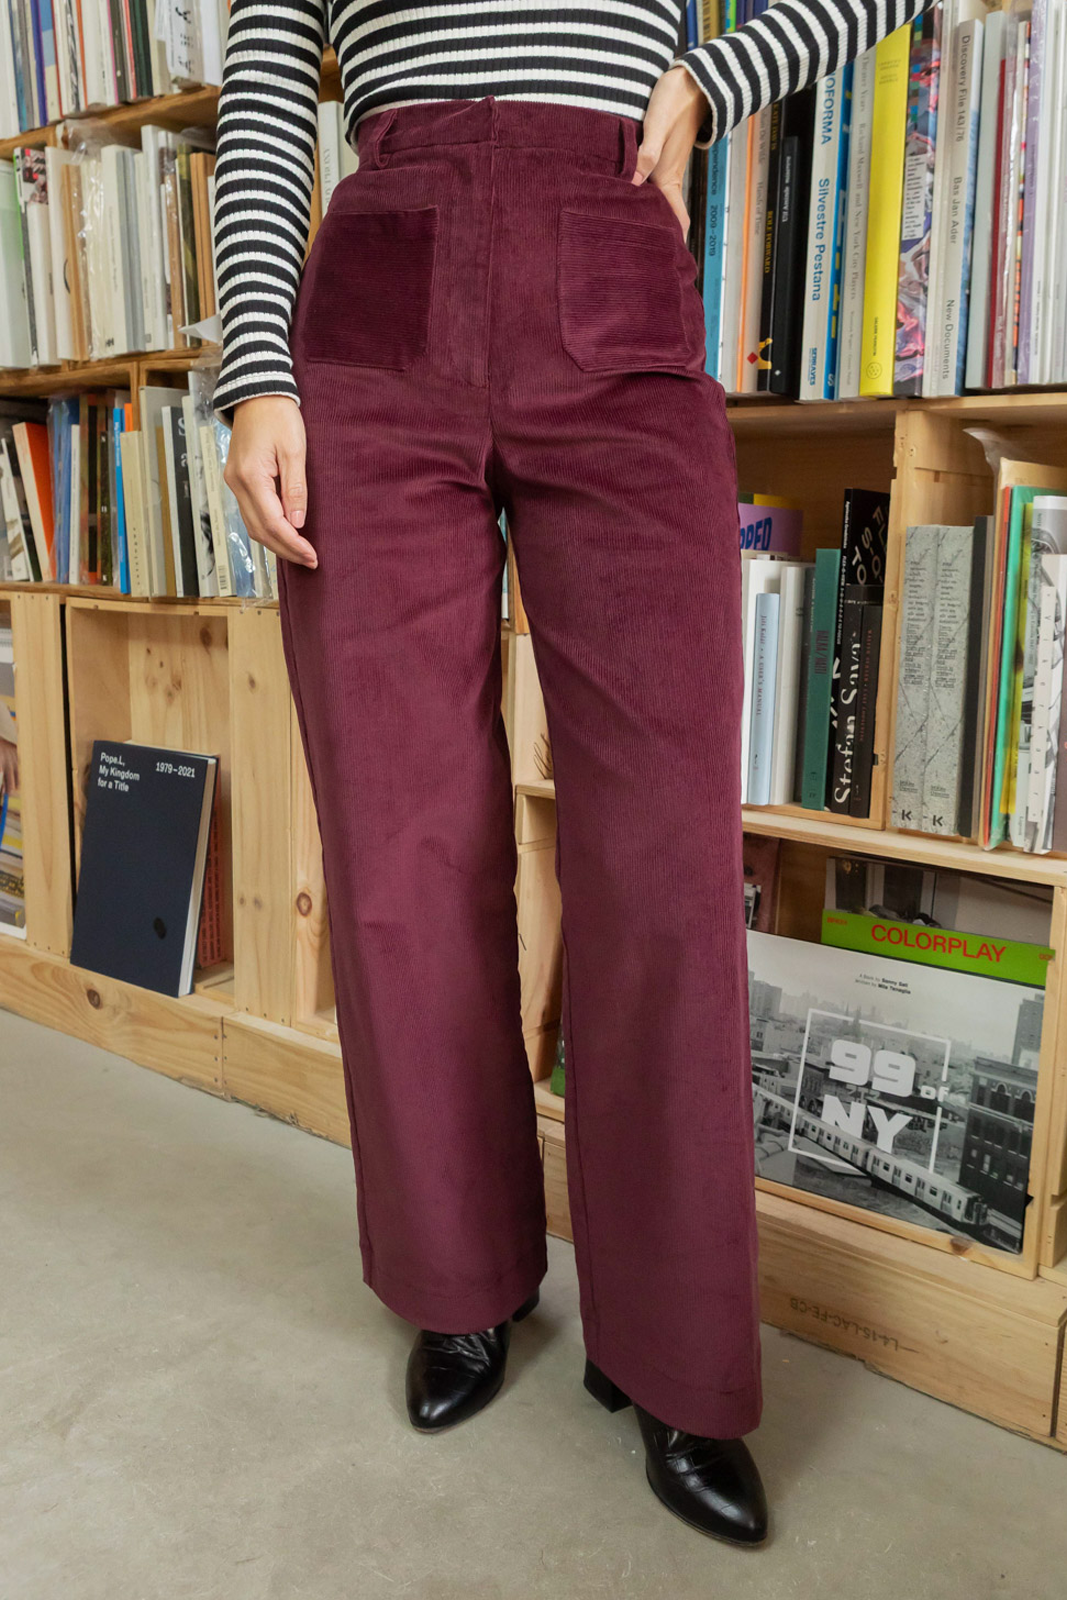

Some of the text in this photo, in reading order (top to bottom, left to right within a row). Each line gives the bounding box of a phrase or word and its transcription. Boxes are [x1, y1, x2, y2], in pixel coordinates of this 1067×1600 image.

[959, 35, 972, 86] Discovery
[957, 88, 968, 107] File
[949, 177, 963, 245] Bas Jan Ader
[811, 178, 830, 301] Silvestre Pestana
[942, 299, 956, 381] New Documents
[97, 777, 129, 792] for a Title
[98, 765, 140, 781] My Kingdom
[901, 809, 912, 821] K
[932, 815, 944, 827] K
[871, 924, 1007, 963] COLORPLAY
[829, 1039, 917, 1098] 99
[920, 1084, 950, 1103] of
[820, 1094, 914, 1155] NY
